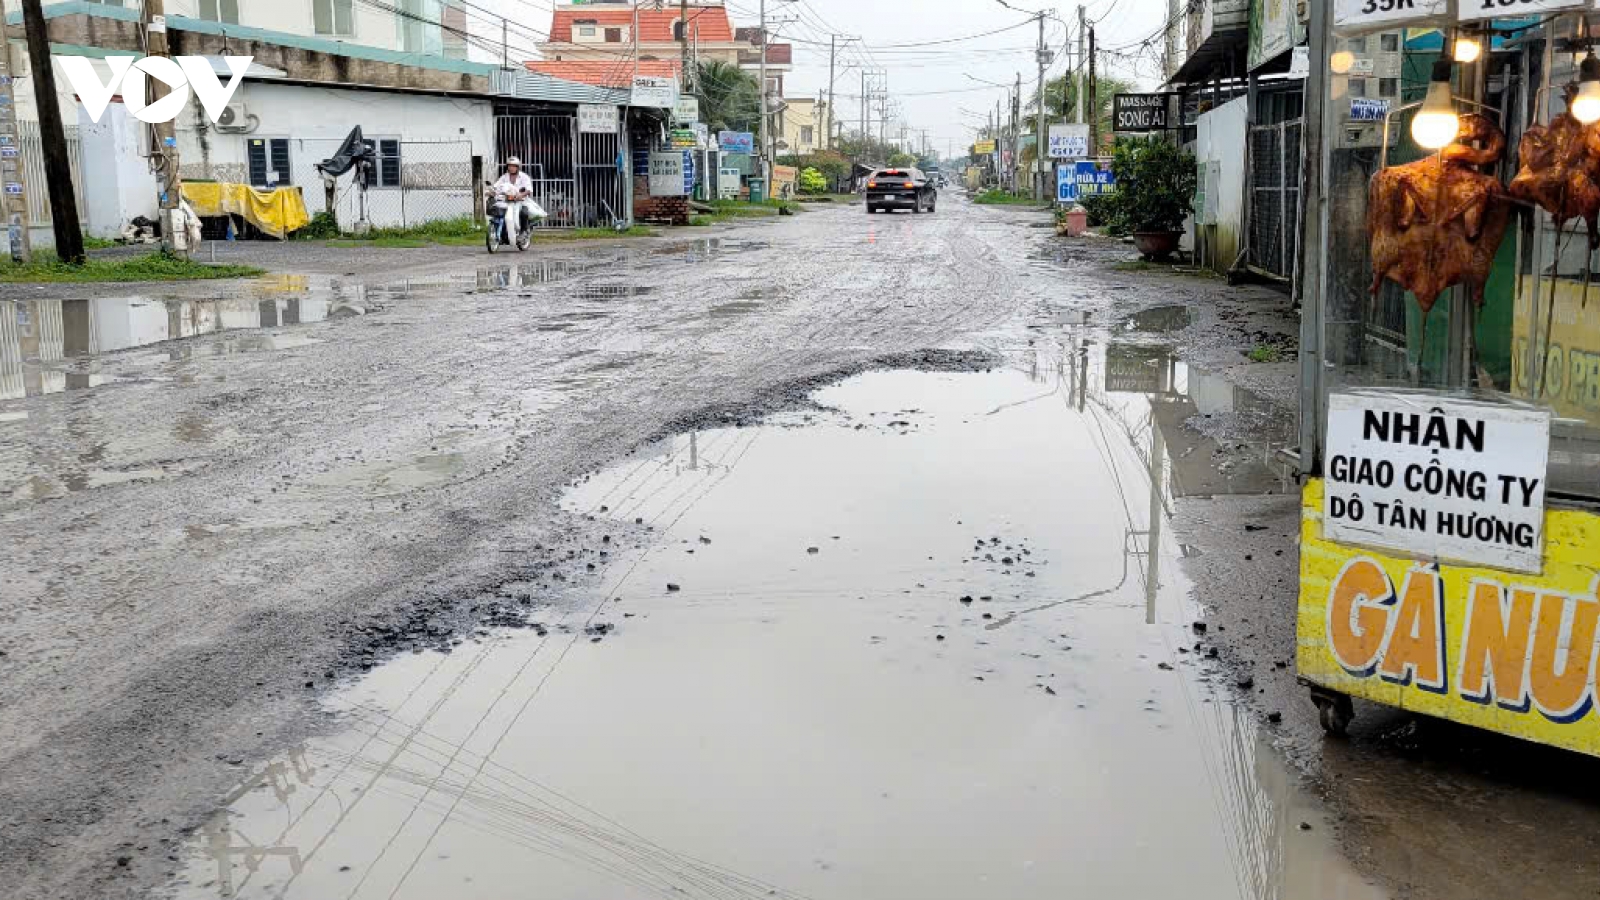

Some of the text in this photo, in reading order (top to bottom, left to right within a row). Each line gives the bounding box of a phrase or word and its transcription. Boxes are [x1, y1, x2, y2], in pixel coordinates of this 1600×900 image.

[1120, 95, 1164, 108] MASSAGE
[1118, 110, 1149, 127] SONG
[1059, 183, 1075, 198] 60
[1363, 406, 1485, 454] NHẬN
[1330, 454, 1539, 508] GIAO CÔNG TY
[1330, 492, 1534, 549] DÔ TÂN HƯƠNG
